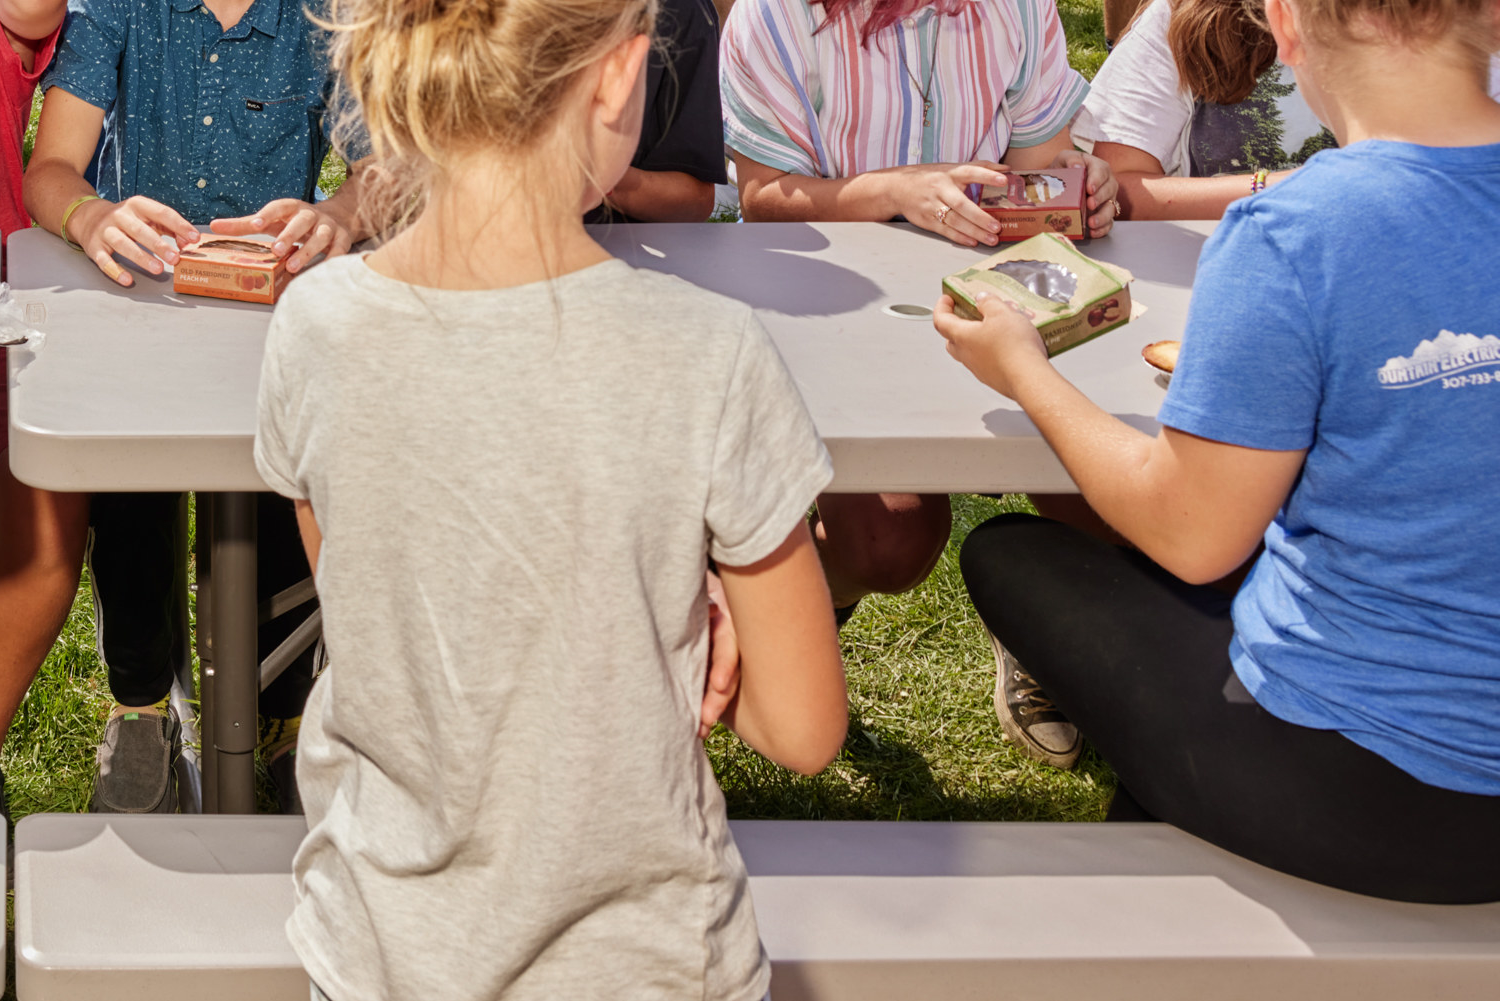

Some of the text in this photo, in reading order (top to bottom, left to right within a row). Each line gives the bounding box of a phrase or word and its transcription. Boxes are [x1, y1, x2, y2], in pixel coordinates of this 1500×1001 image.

[179, 274, 199, 283] PEACH
[180, 267, 231, 280] OLD FASHIONED
[1440, 344, 1500, 372] ELECTRIC
